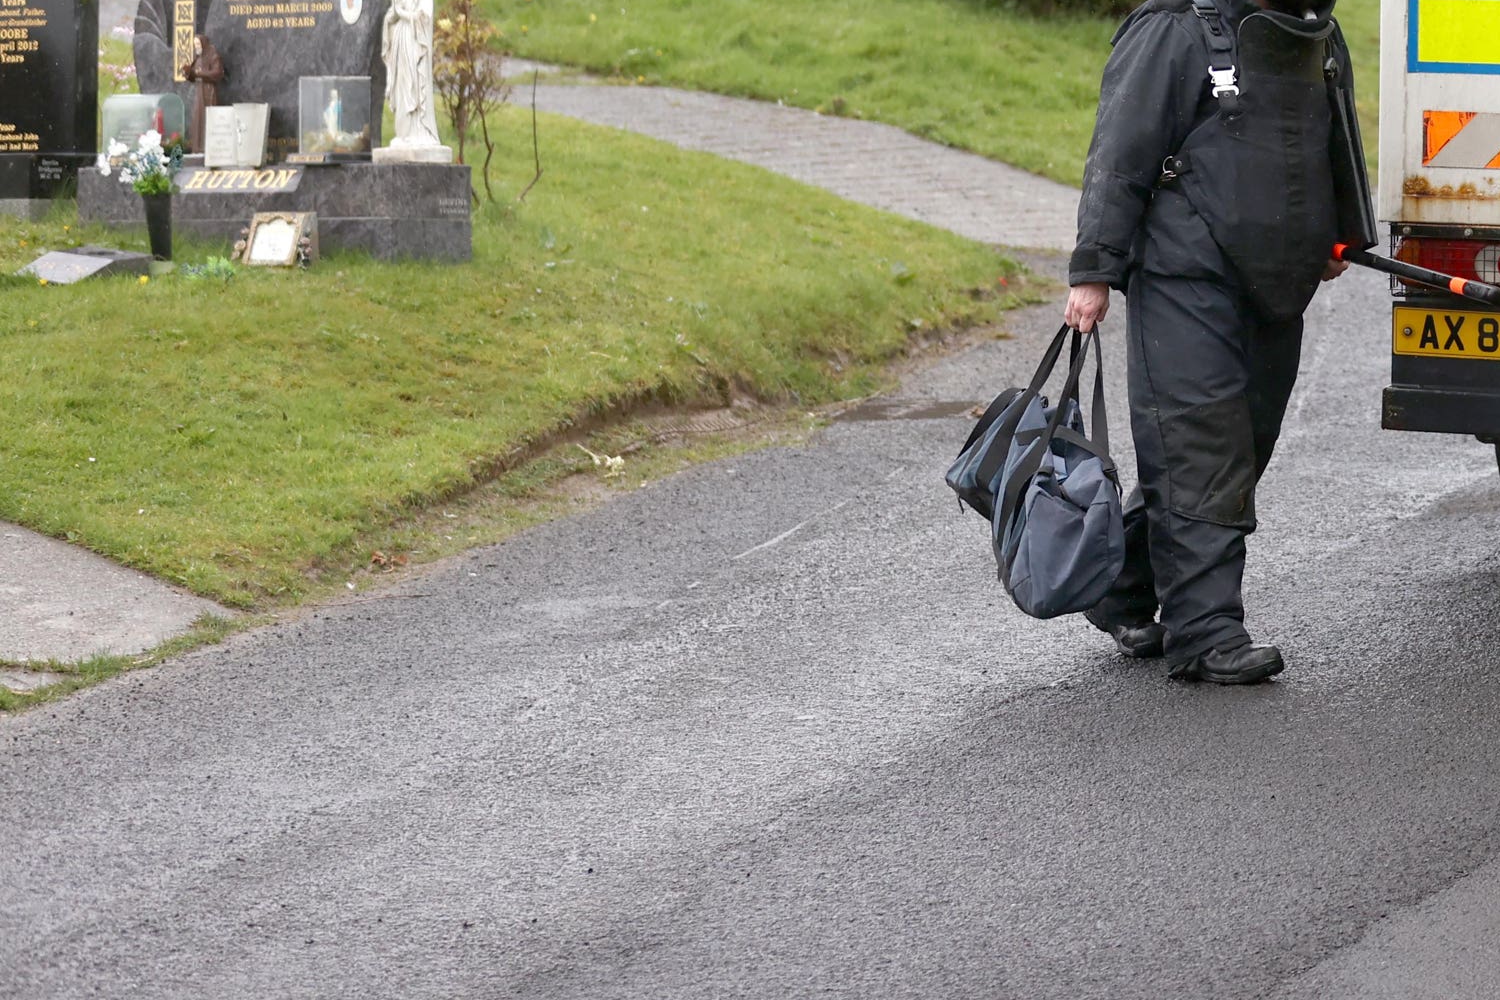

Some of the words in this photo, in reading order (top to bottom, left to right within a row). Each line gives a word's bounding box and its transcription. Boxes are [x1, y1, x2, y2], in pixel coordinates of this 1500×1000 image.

[229, 4, 253, 16] DIED
[276, 2, 310, 14] MARCH
[310, 2, 334, 14] 2009
[246, 18, 272, 29] AGED
[285, 16, 316, 28] YEARS
[0, 28, 29, 40] OORE
[0, 41, 15, 52] pril
[16, 40, 39, 52] 2012
[1, 53, 25, 63] Years
[184, 168, 298, 190] HUTTON
[1418, 314, 1465, 351] AX
